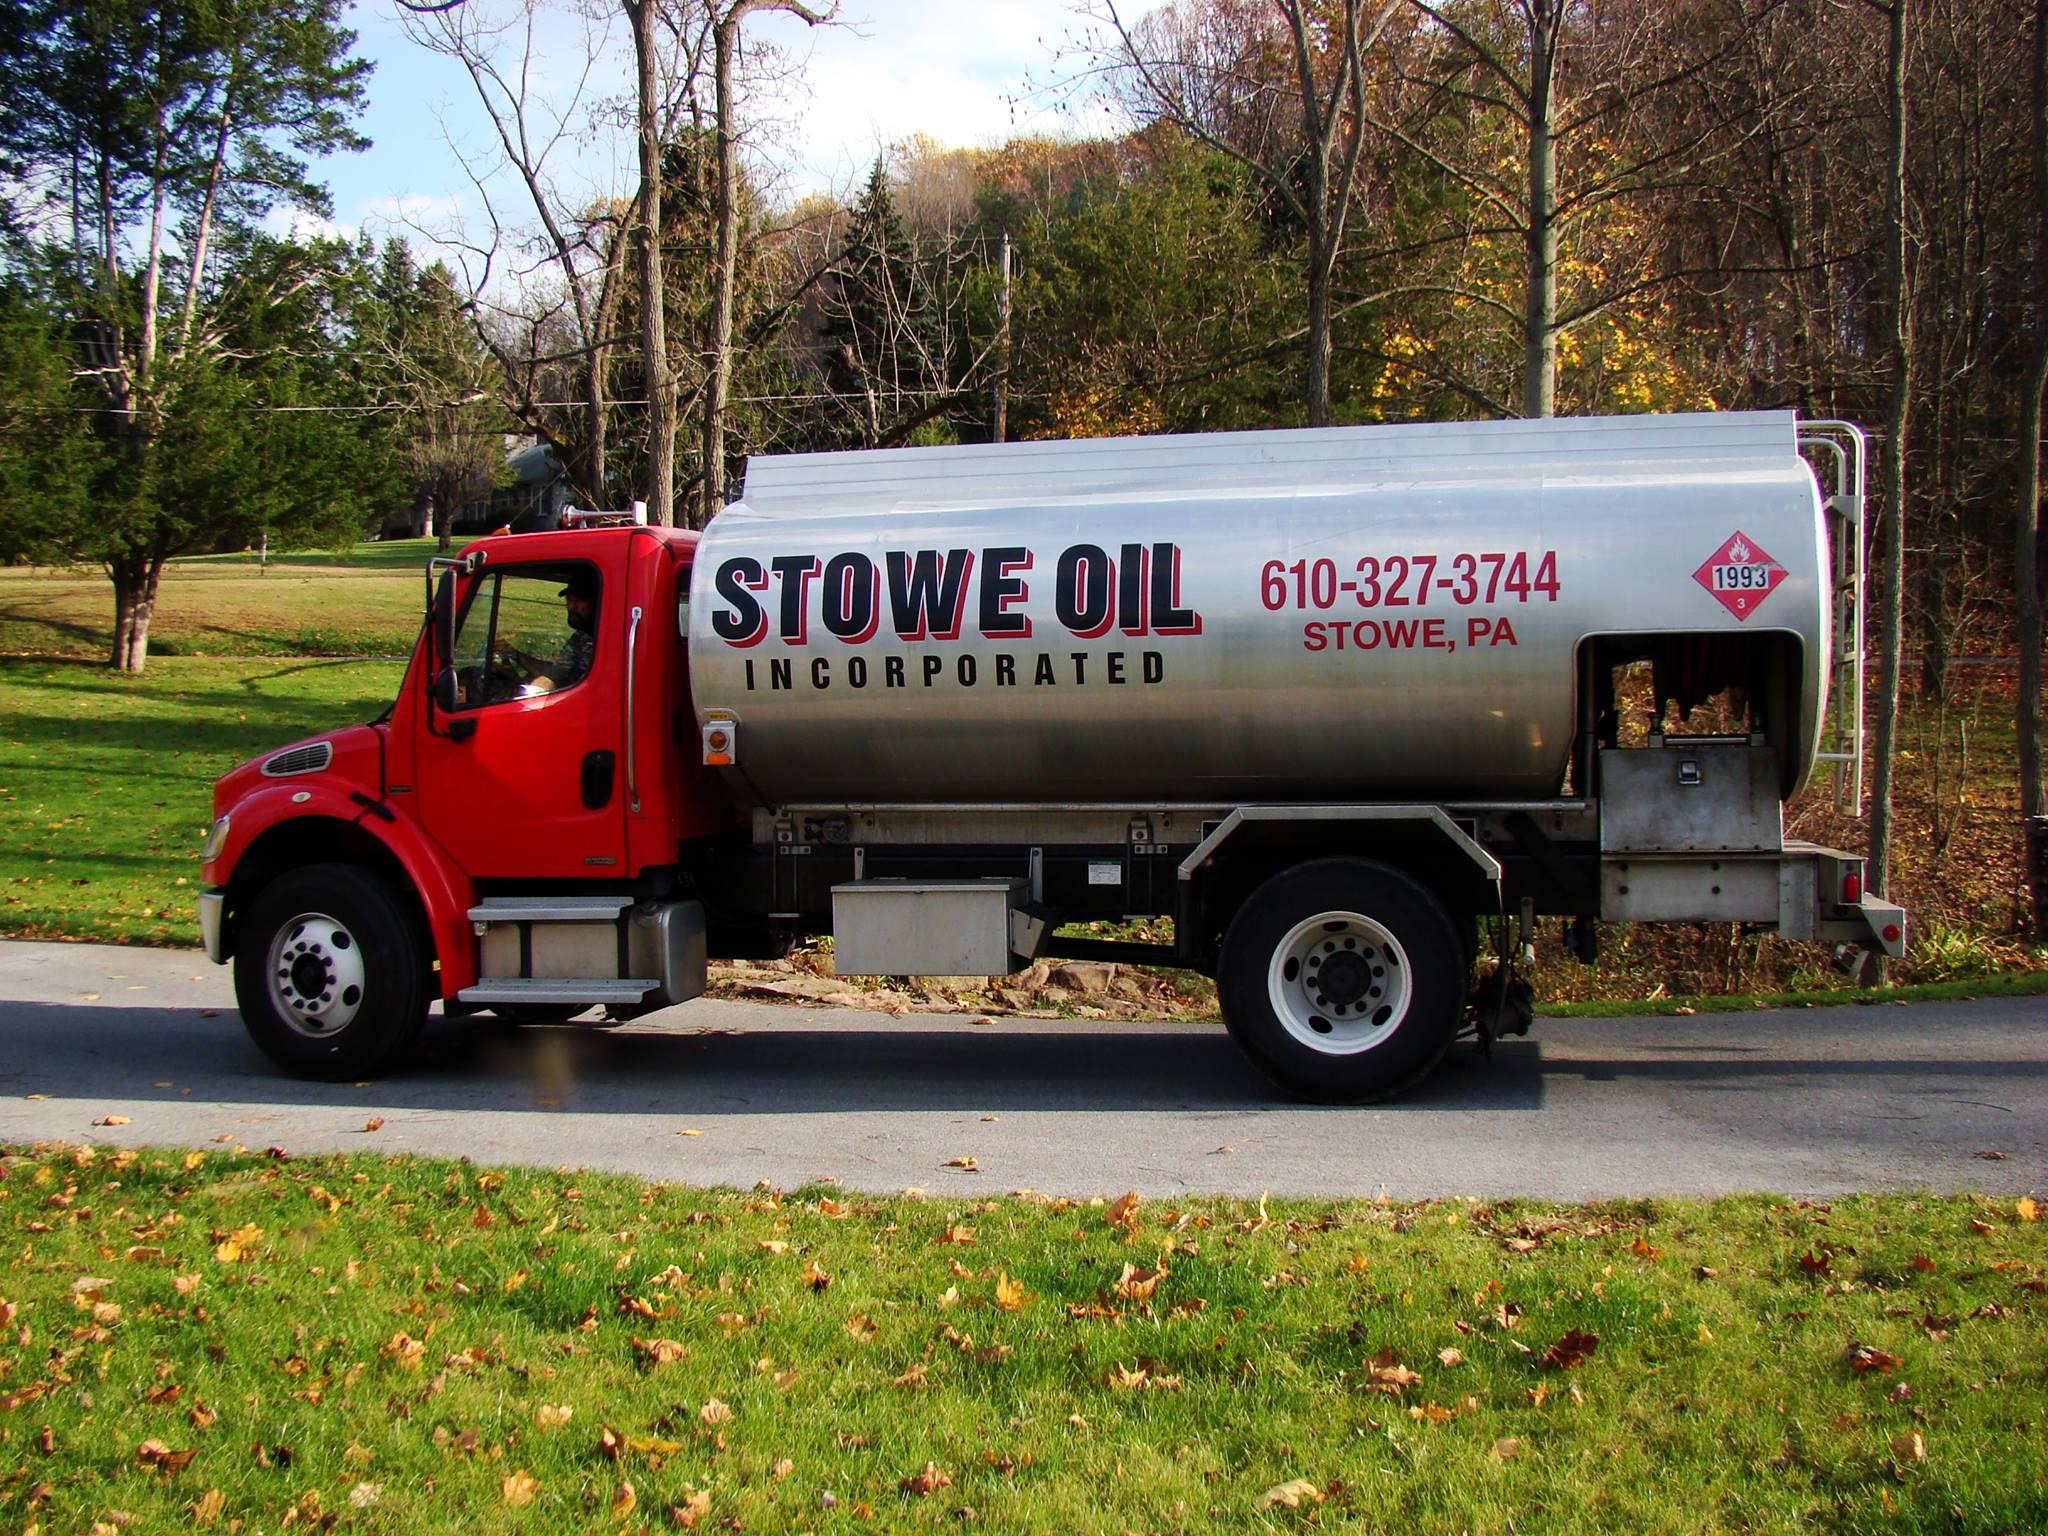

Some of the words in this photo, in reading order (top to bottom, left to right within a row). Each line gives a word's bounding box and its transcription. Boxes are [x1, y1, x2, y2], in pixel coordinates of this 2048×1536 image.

[711, 547, 1034, 648] STOWE
[1055, 542, 1202, 639] OIL
[1260, 550, 1561, 611] 610-327-3744
[1715, 566, 1767, 589] 1993
[1736, 597, 1746, 609] 3
[1303, 618, 1456, 654] STOWE,
[1467, 616, 1518, 648] PA
[745, 651, 1165, 691] INCORPORATED
